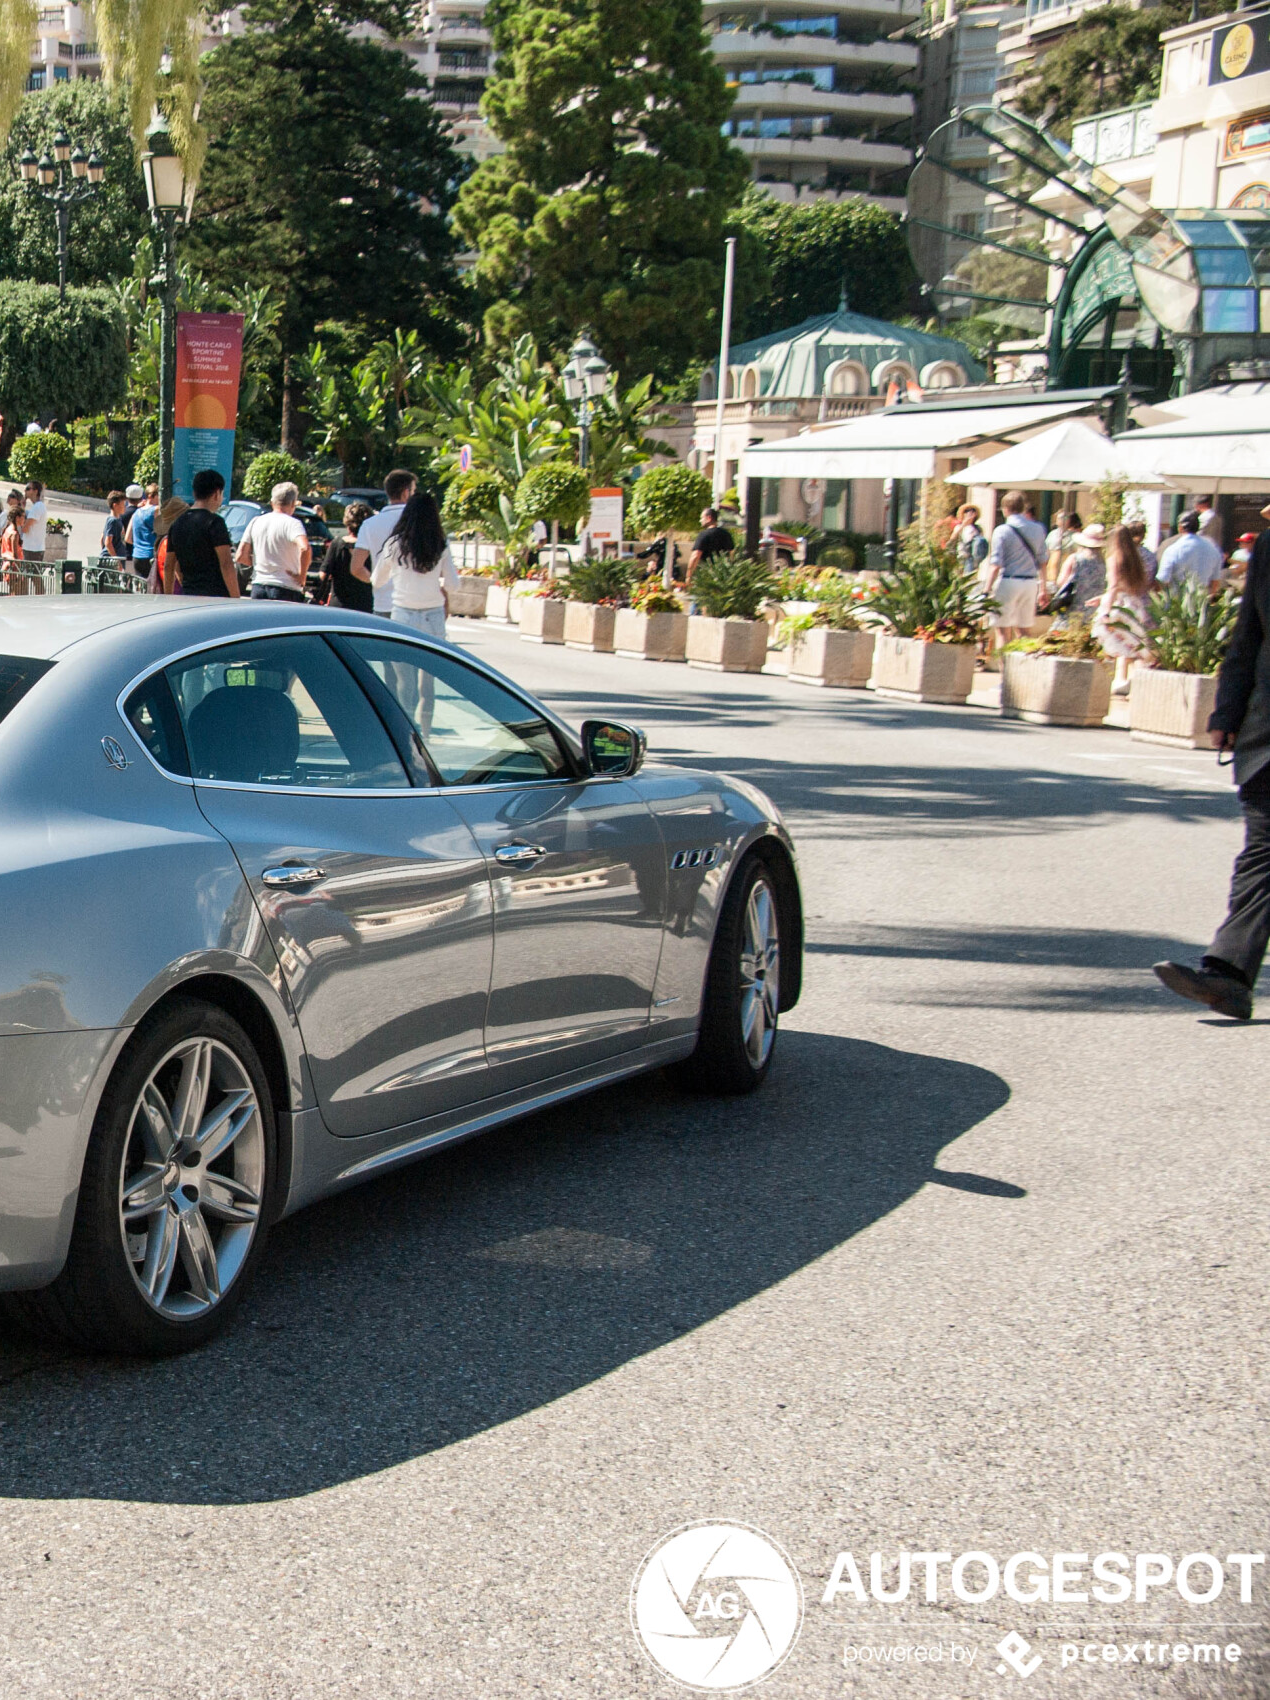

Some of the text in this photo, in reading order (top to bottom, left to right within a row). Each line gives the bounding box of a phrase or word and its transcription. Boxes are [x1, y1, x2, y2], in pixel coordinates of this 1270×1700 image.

[186, 340, 232, 349] MONTE CARLO
[192, 348, 224, 356] SPORTING
